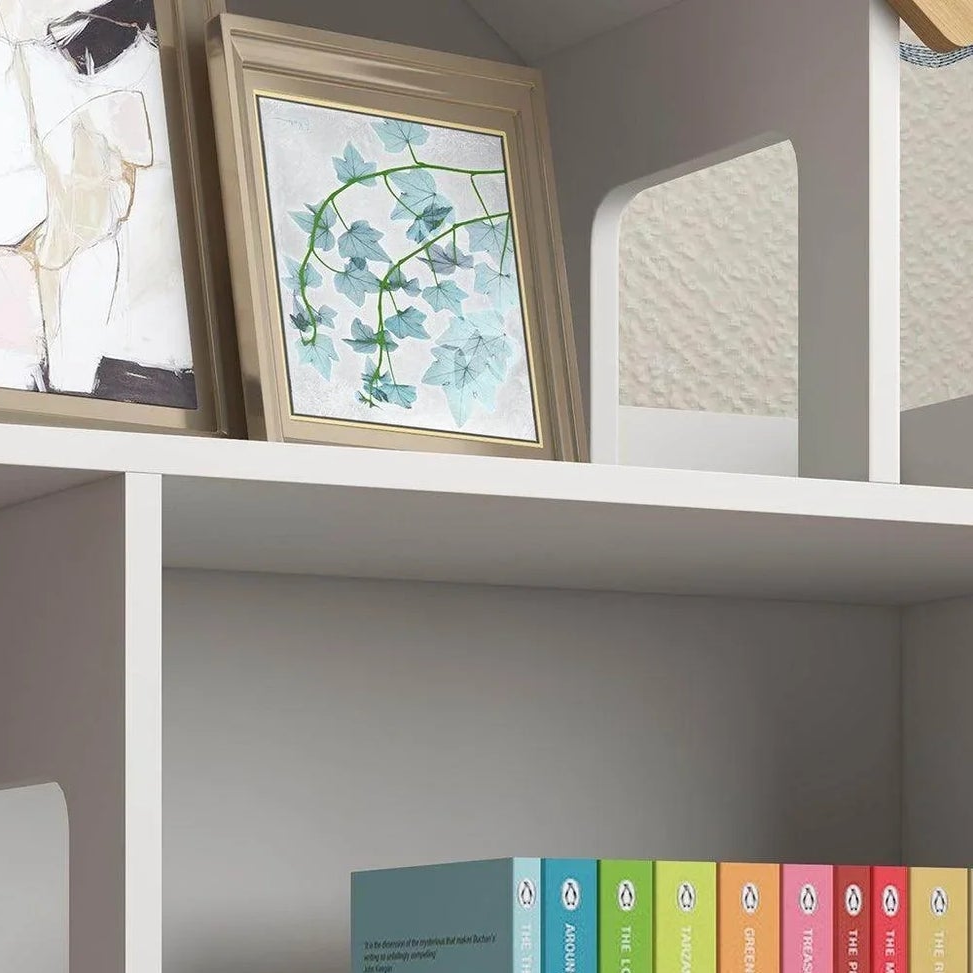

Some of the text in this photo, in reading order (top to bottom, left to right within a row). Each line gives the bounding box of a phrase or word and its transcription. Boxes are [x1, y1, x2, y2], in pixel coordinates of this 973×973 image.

[521, 924, 532, 950] THE
[621, 926, 632, 952] THE
[848, 929, 858, 955] THE
[885, 930, 895, 956] THE
[934, 931, 944, 957] THE
